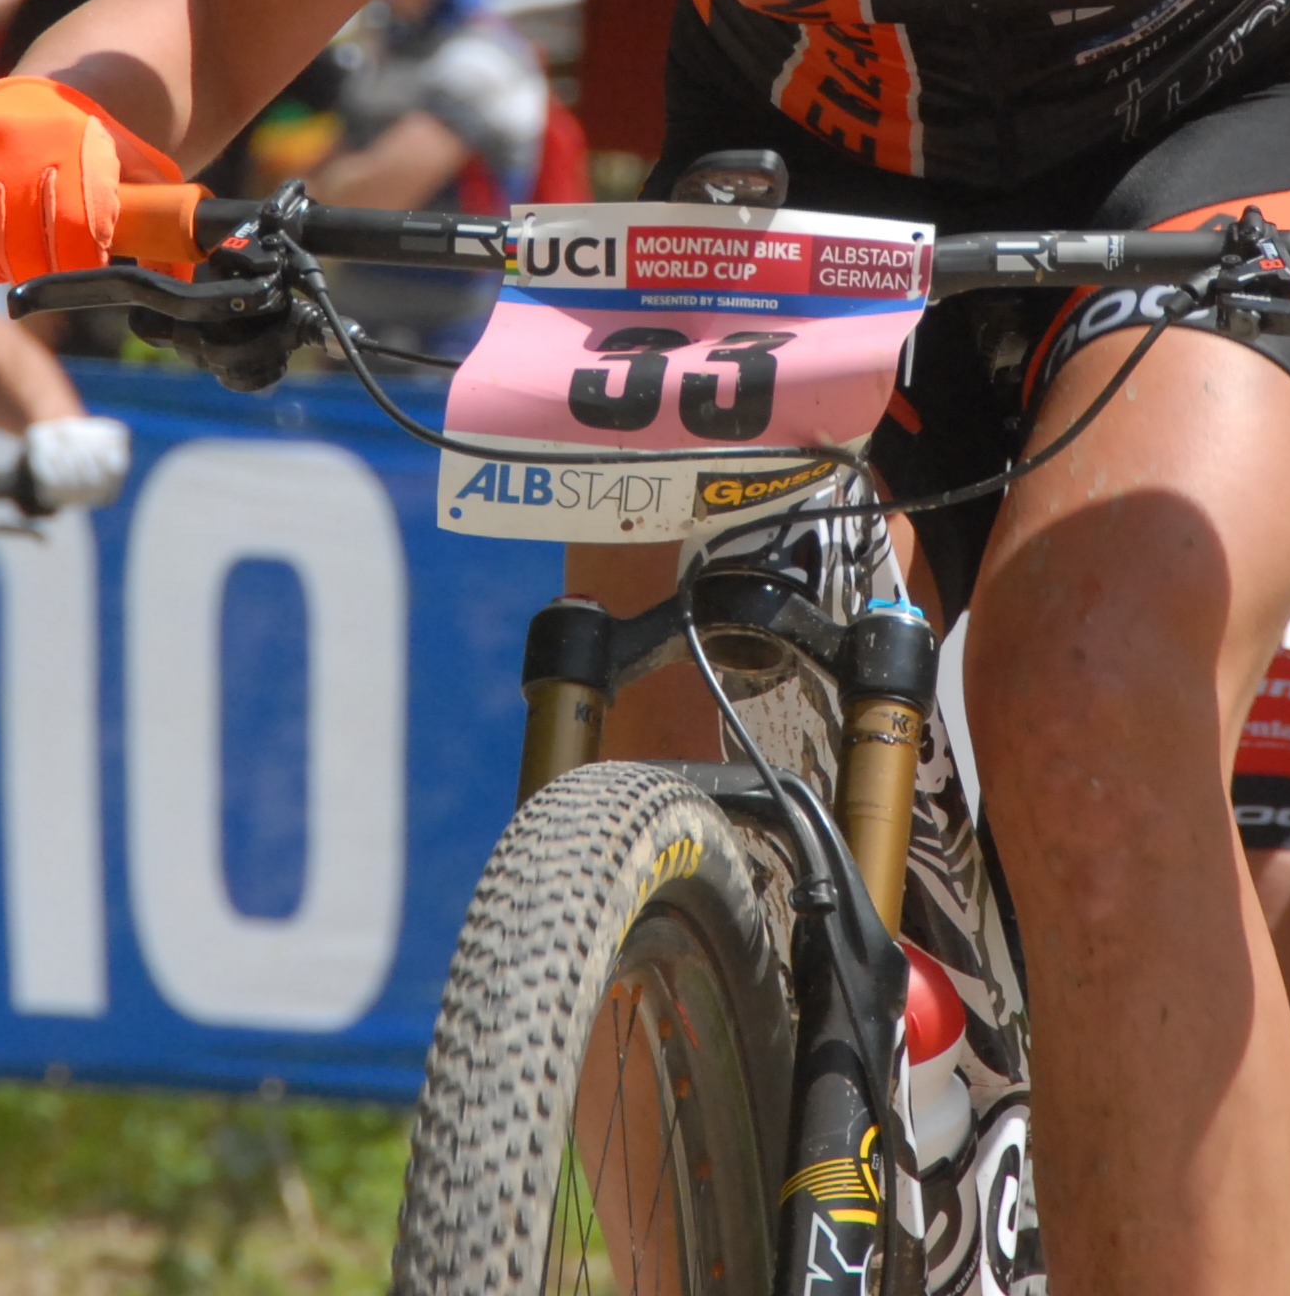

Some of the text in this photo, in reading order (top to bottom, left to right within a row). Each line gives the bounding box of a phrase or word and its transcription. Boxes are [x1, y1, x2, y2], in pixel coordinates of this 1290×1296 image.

[525, 236, 616, 277] UCI
[635, 236, 802, 261] MOUNTAIN BIKE
[819, 245, 914, 268] ALBSTADT
[635, 260, 757, 282] WORLD CUP
[641, 294, 779, 311] PRESENTED BY SHIMANO
[568, 326, 798, 442] 33
[455, 462, 672, 514] ALBSTADT
